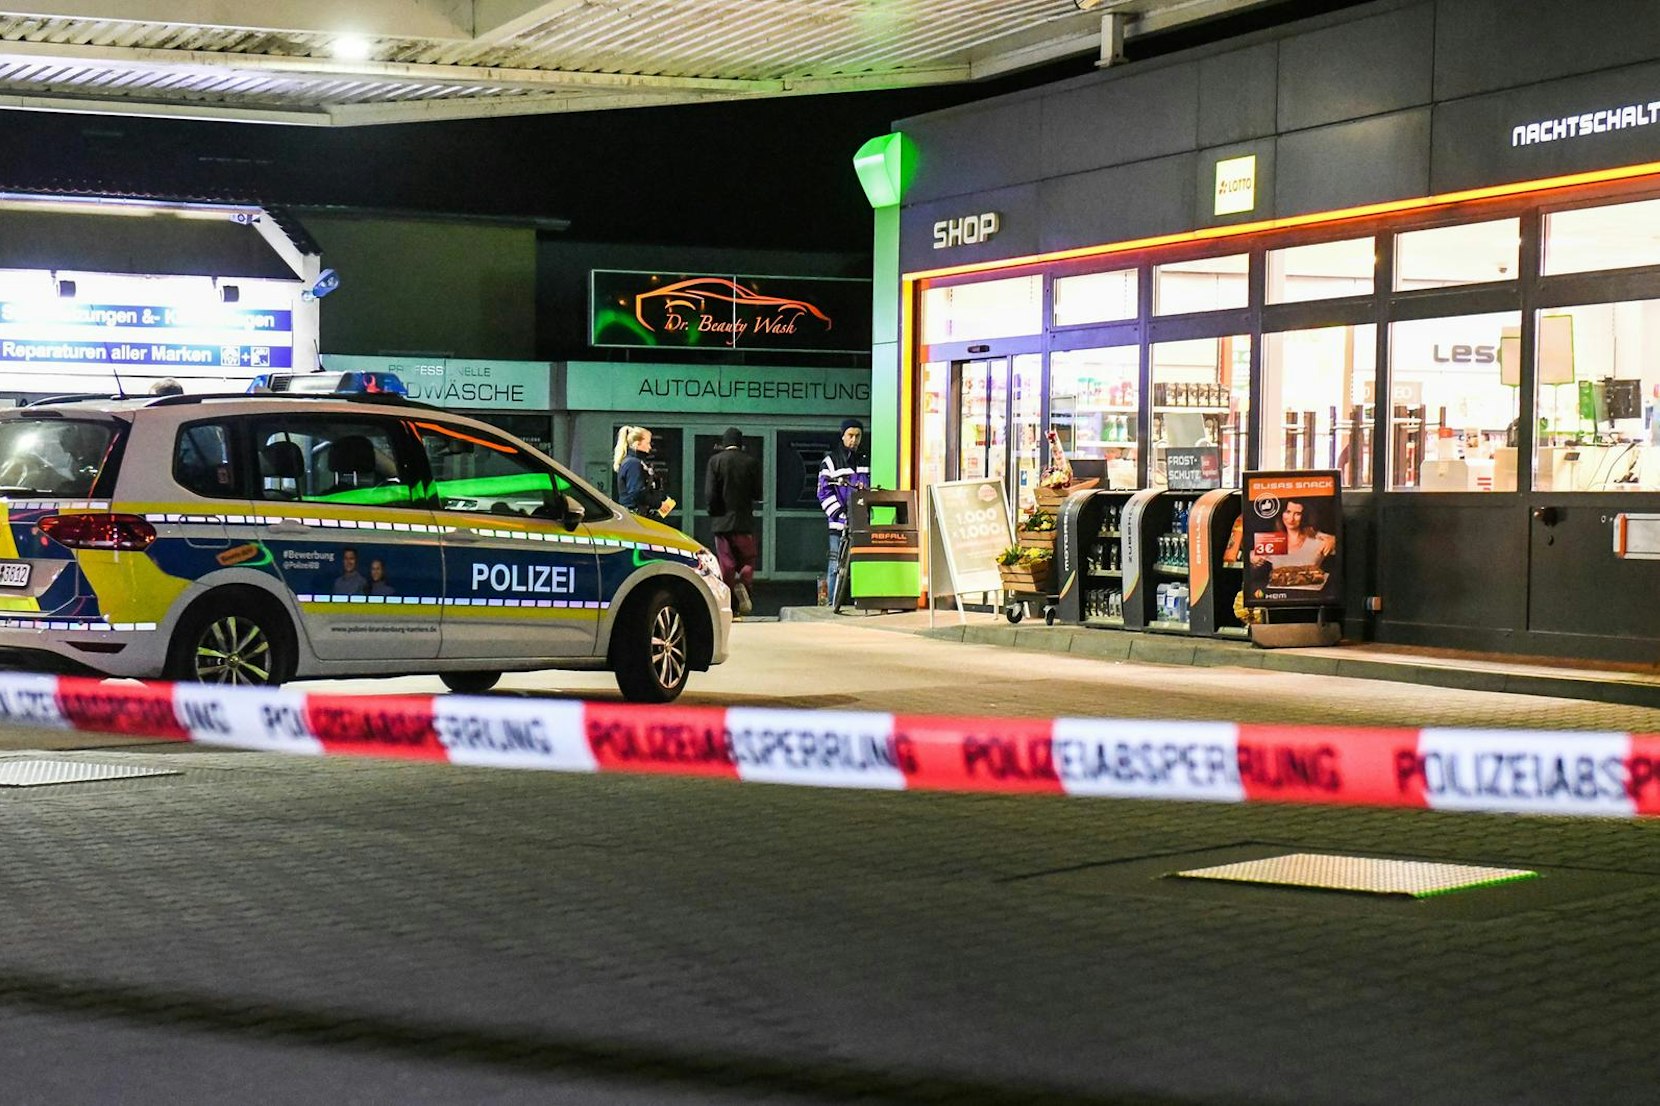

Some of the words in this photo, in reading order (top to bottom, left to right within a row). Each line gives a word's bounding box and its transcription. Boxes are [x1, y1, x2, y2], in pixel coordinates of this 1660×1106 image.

[1512, 101, 1660, 147] NACHTSCHALT
[1228, 177, 1252, 193] LOTTO
[933, 212, 998, 250] SHOP
[664, 313, 688, 331] Dr.
[697, 313, 748, 345] Beauty
[752, 311, 805, 335] Wash
[2, 341, 106, 361] Reparaturen
[111, 345, 147, 361] aller
[151, 346, 212, 362] Marken
[638, 378, 870, 400] AUTOAUFBEREITUNG
[1168, 455, 1198, 466] FROST-
[1168, 470, 1201, 480] SCHUTZ
[1296, 480, 1334, 489] SNACK
[283, 550, 335, 562] #Bewerbung
[1256, 543, 1275, 554] 3€
[471, 562, 576, 594] POLIZEI
